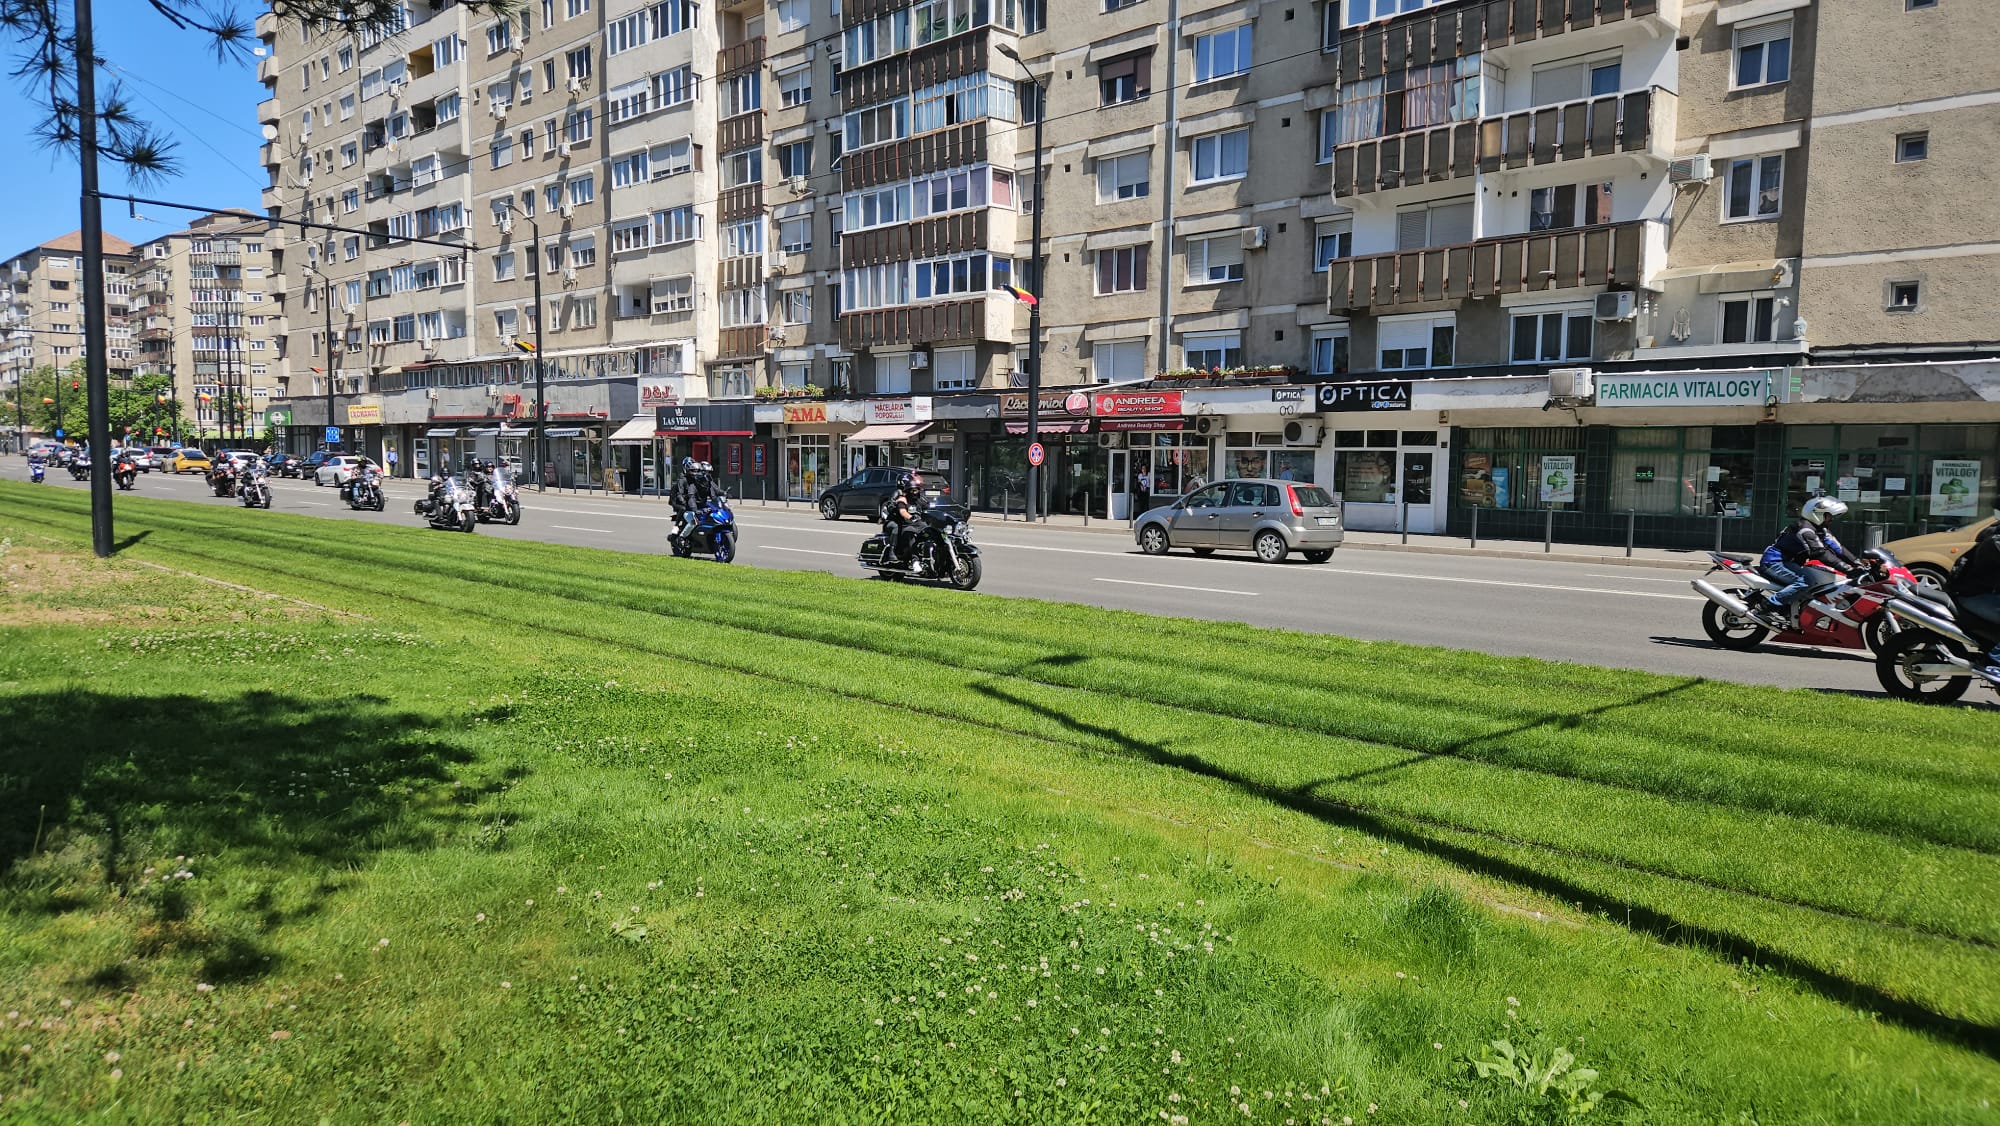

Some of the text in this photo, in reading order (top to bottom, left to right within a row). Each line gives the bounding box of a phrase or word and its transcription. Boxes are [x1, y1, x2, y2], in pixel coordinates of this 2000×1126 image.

[1600, 379, 1761, 399] FARMACIA VITALOGY
[1115, 396, 1166, 405] ANDREEA
[1276, 391, 1301, 399] OPTICA
[1320, 386, 1406, 404] OPTICA
[790, 407, 826, 422] AMA
[662, 416, 697, 426] LAS VEGAS
[1935, 467, 1978, 478] VITALOGY
